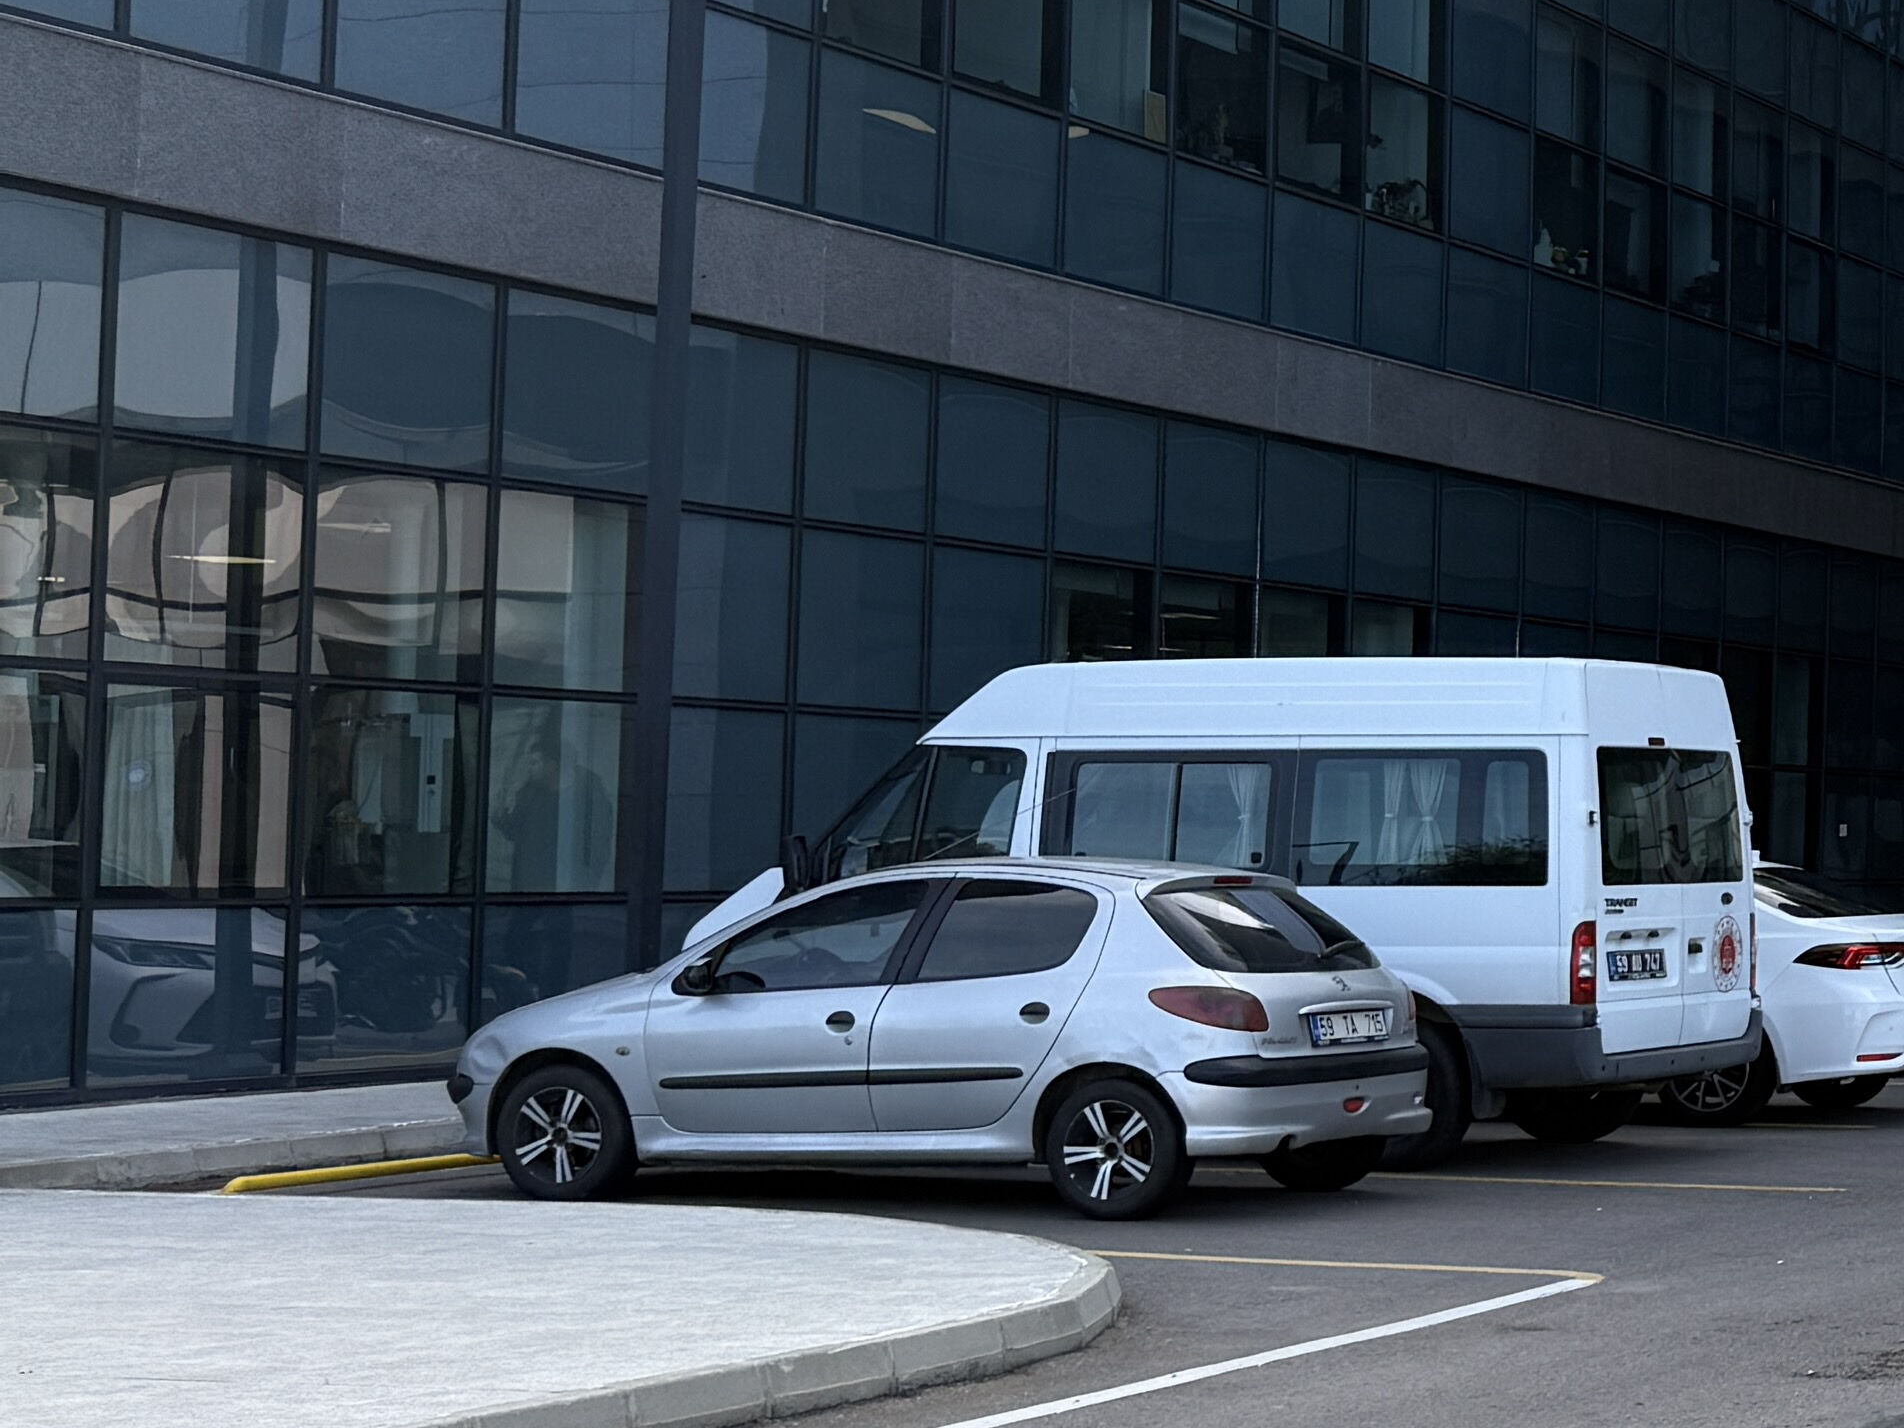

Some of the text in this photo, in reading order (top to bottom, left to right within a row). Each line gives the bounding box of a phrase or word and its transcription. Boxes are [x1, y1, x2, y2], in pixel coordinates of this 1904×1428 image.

[1318, 1012, 1384, 1037] 59 TA 715
